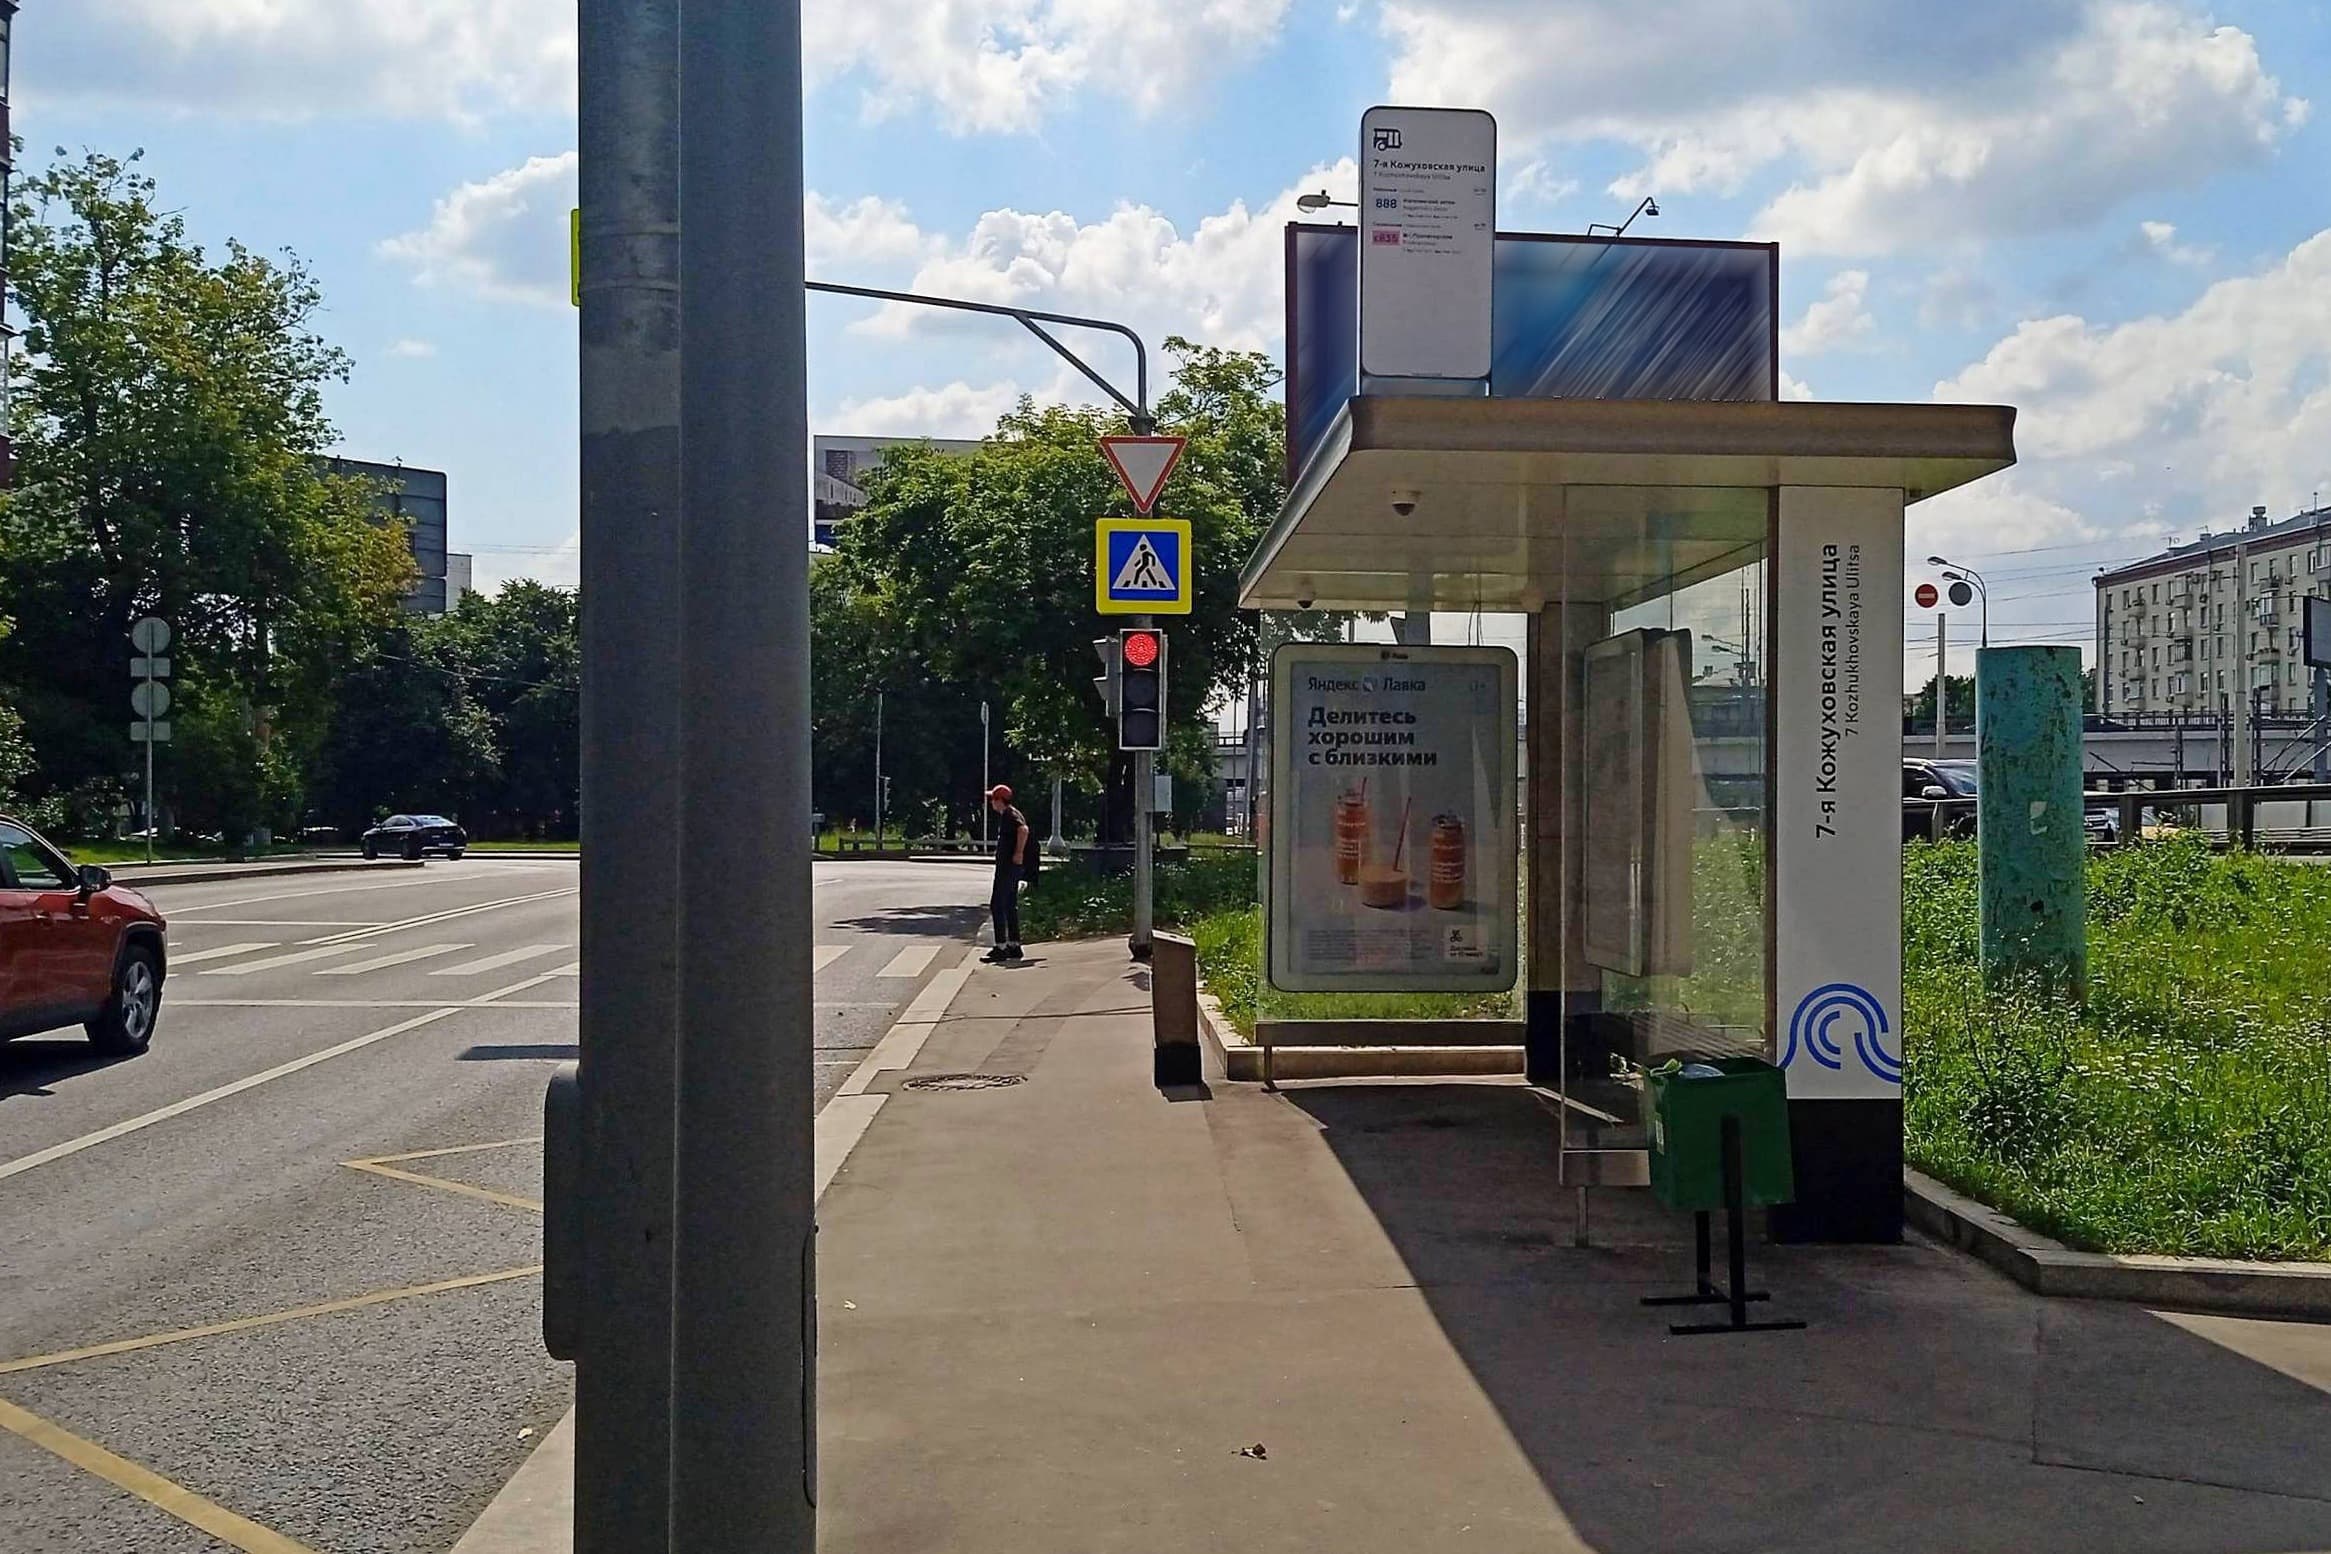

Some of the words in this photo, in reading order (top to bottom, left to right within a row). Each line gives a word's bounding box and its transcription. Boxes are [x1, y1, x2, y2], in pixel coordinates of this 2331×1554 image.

[1390, 160, 1454, 171] Кожуховская
[1456, 164, 1486, 172] улица
[1375, 198, 1398, 209] 888
[1845, 544, 1860, 589] Ulitsa
[1821, 543, 1842, 620] улица
[1844, 592, 1862, 724] Kozhukhovskaya
[1308, 676, 1359, 692] Яндекс
[1382, 677, 1426, 692] Лавка
[1307, 706, 1417, 728] Делитесь
[1815, 625, 1842, 793] Кожуховская
[1307, 731, 1415, 749] хорошим
[1845, 727, 1859, 737] 7
[1308, 751, 1320, 765] с
[1325, 748, 1437, 766] близкими
[1815, 800, 1837, 839] 7-я
